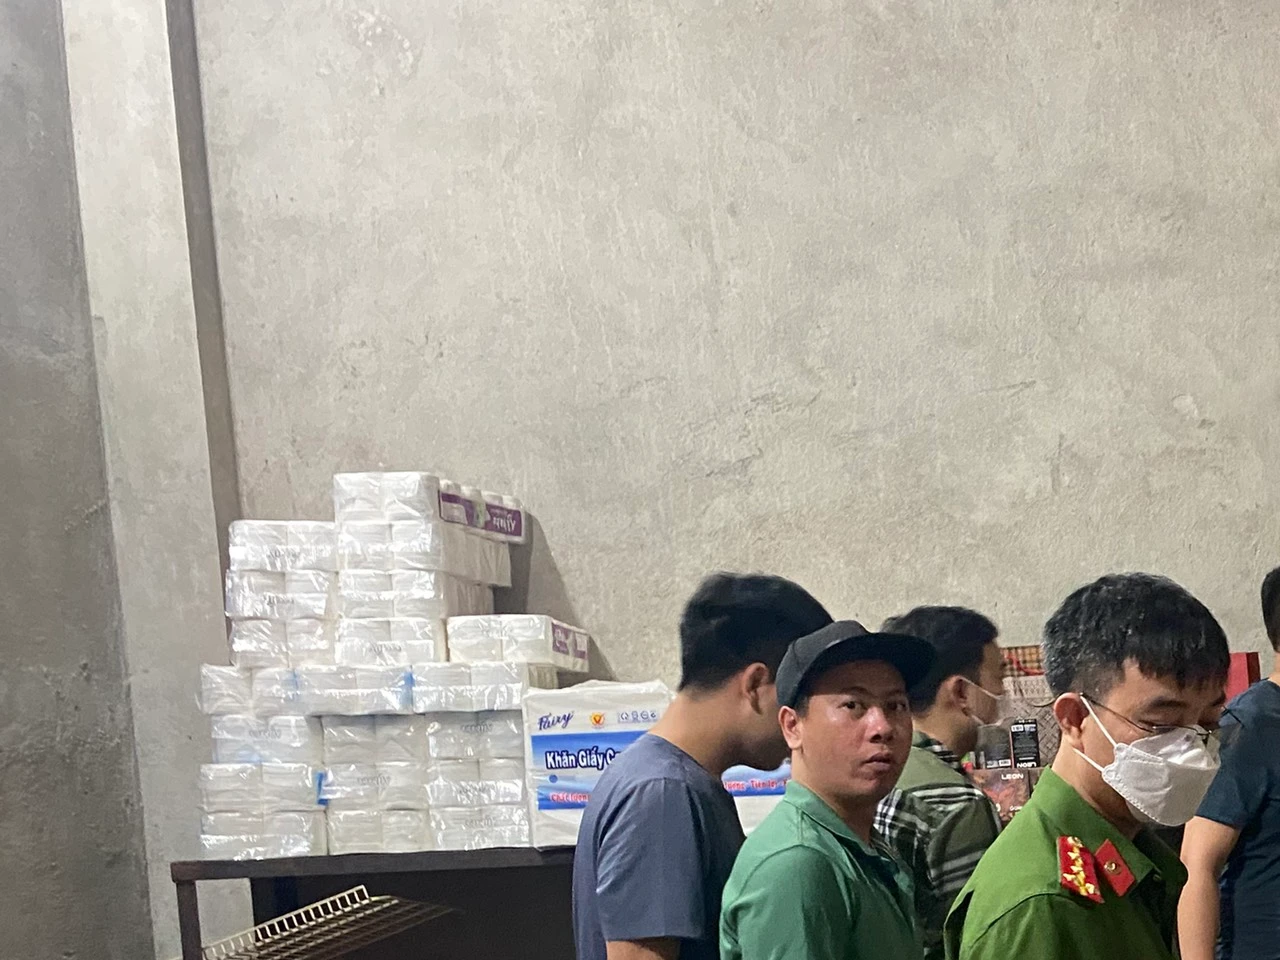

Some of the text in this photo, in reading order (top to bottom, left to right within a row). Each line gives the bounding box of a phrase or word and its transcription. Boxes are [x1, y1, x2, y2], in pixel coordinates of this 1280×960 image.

[545, 750, 578, 769] Khăn
[578, 746, 604, 771] Giấy
[1001, 772, 1024, 780] LEON
